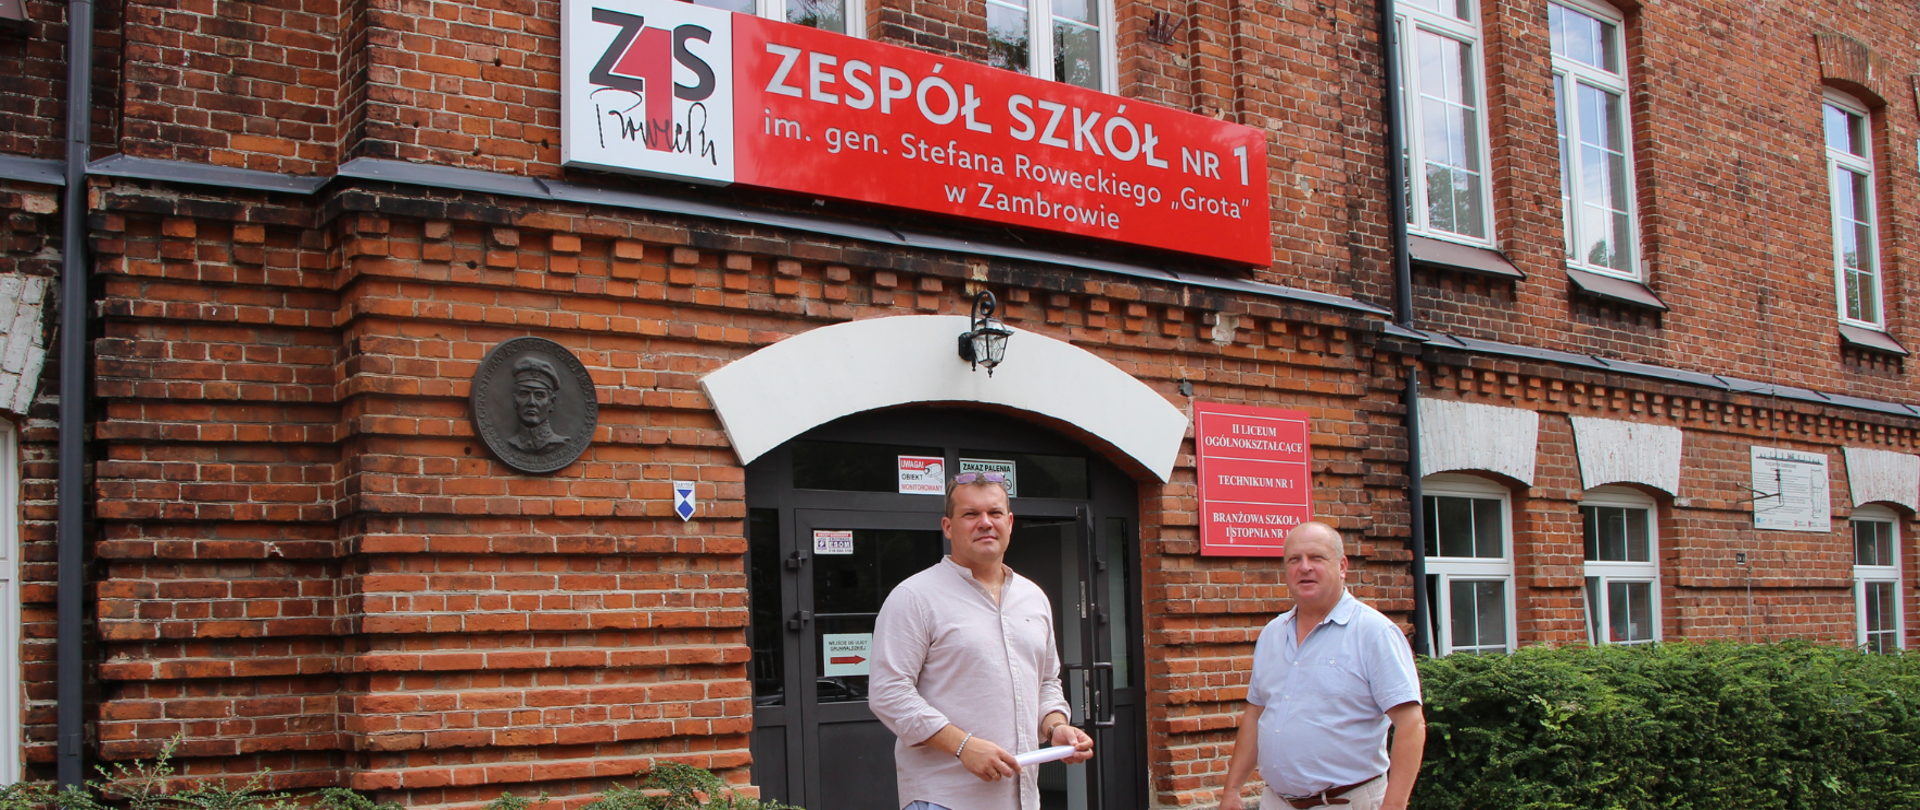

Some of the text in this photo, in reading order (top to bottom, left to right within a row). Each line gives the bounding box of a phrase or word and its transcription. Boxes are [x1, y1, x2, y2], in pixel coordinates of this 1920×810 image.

[765, 43, 1250, 186] ZESPÓŁ SZKÓŁ NR 1
[764, 108, 811, 142] im.
[825, 127, 888, 155] gen.
[901, 132, 1005, 176] Stefana
[1015, 154, 1162, 207] Roweckiego
[944, 183, 1120, 230] w Zambrowie
[1232, 424, 1277, 437] II LICEUM
[1205, 434, 1303, 454] OGÓLNOKSZTAŁCĄCE
[901, 459, 925, 469] UWAGA!
[963, 463, 1011, 473] ZAKAZ PALENIA
[901, 473, 923, 481] OBIEKT
[1217, 474, 1274, 488] TECHNIKUM
[1275, 478, 1288, 489] NR
[901, 483, 943, 491] MONITOROWANY
[1213, 511, 1264, 525] BRANŻOWA
[1231, 527, 1270, 539] STOPNIA
[1271, 528, 1284, 539] NR
